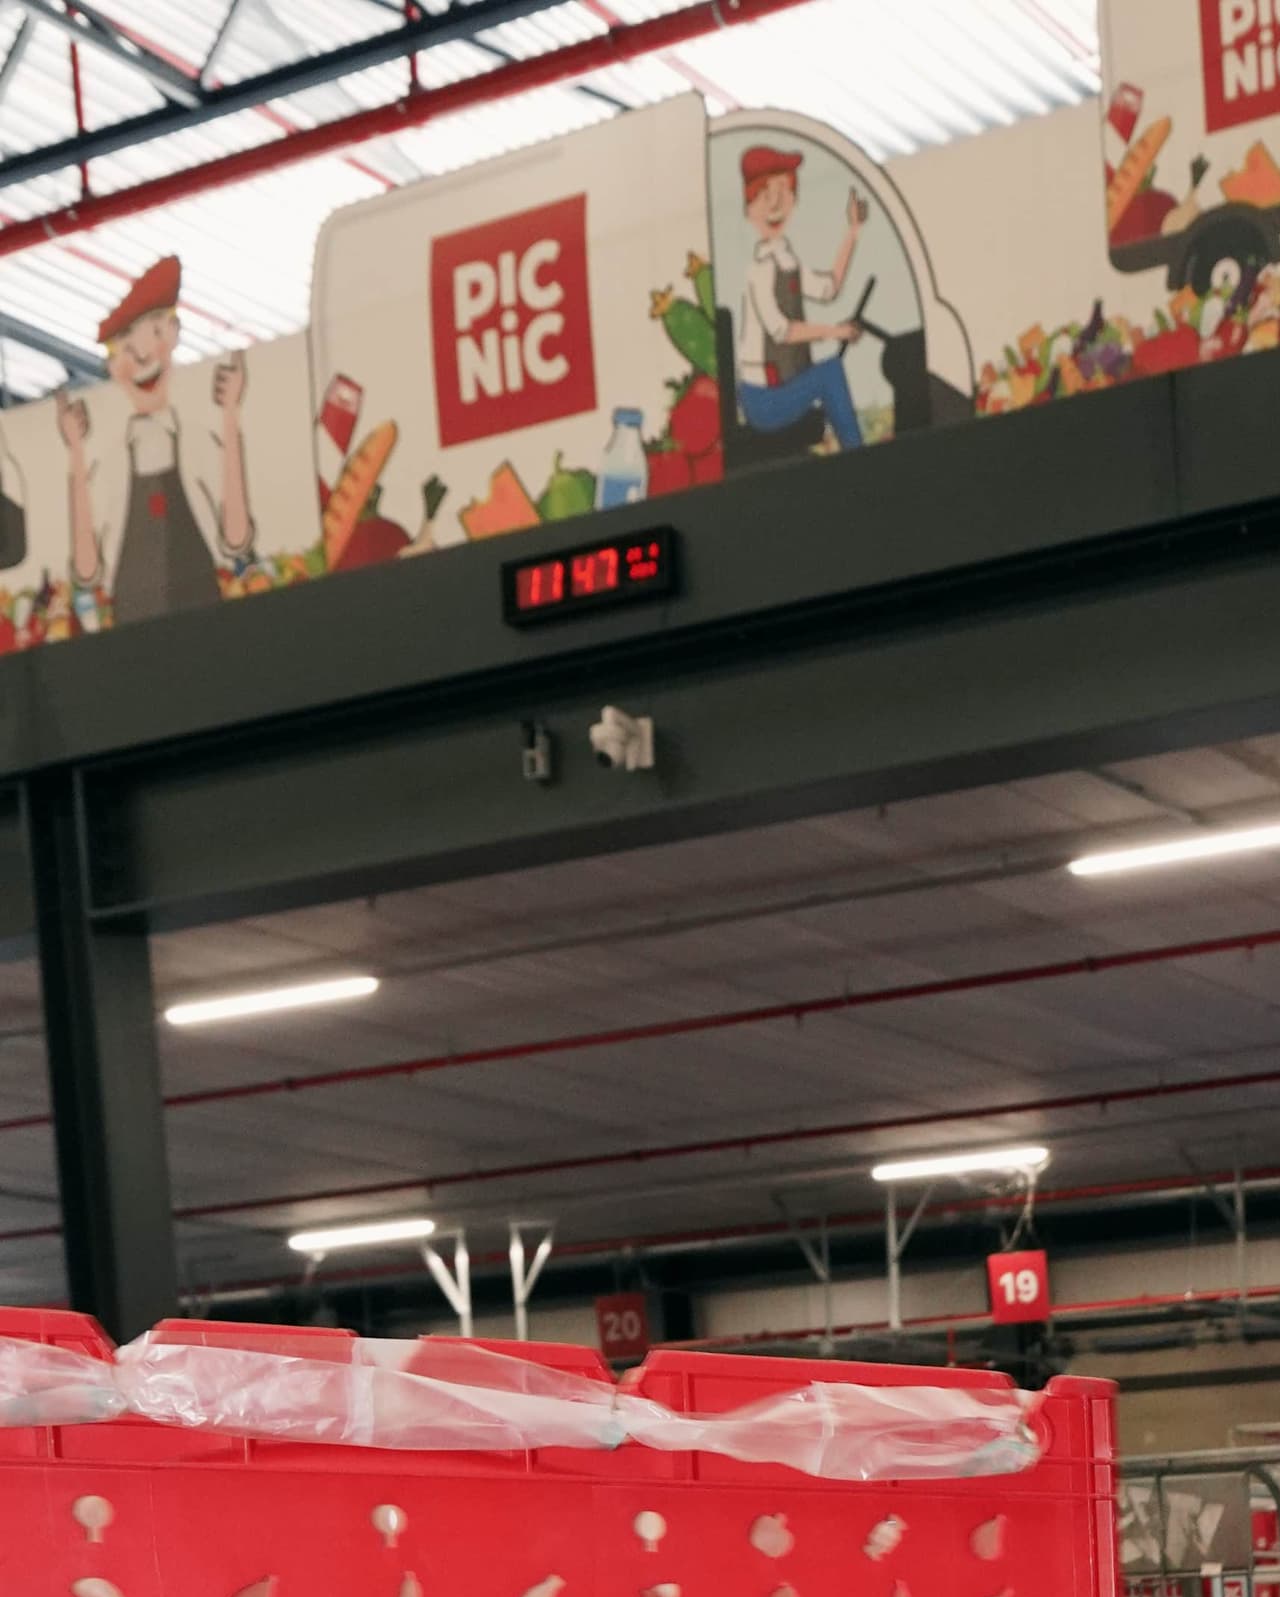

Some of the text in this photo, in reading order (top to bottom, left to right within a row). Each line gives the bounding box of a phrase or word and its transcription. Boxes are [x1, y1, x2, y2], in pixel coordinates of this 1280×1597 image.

[453, 239, 564, 333] PIC
[998, 1269, 1039, 1305] 19
[603, 1311, 641, 1341] 20
